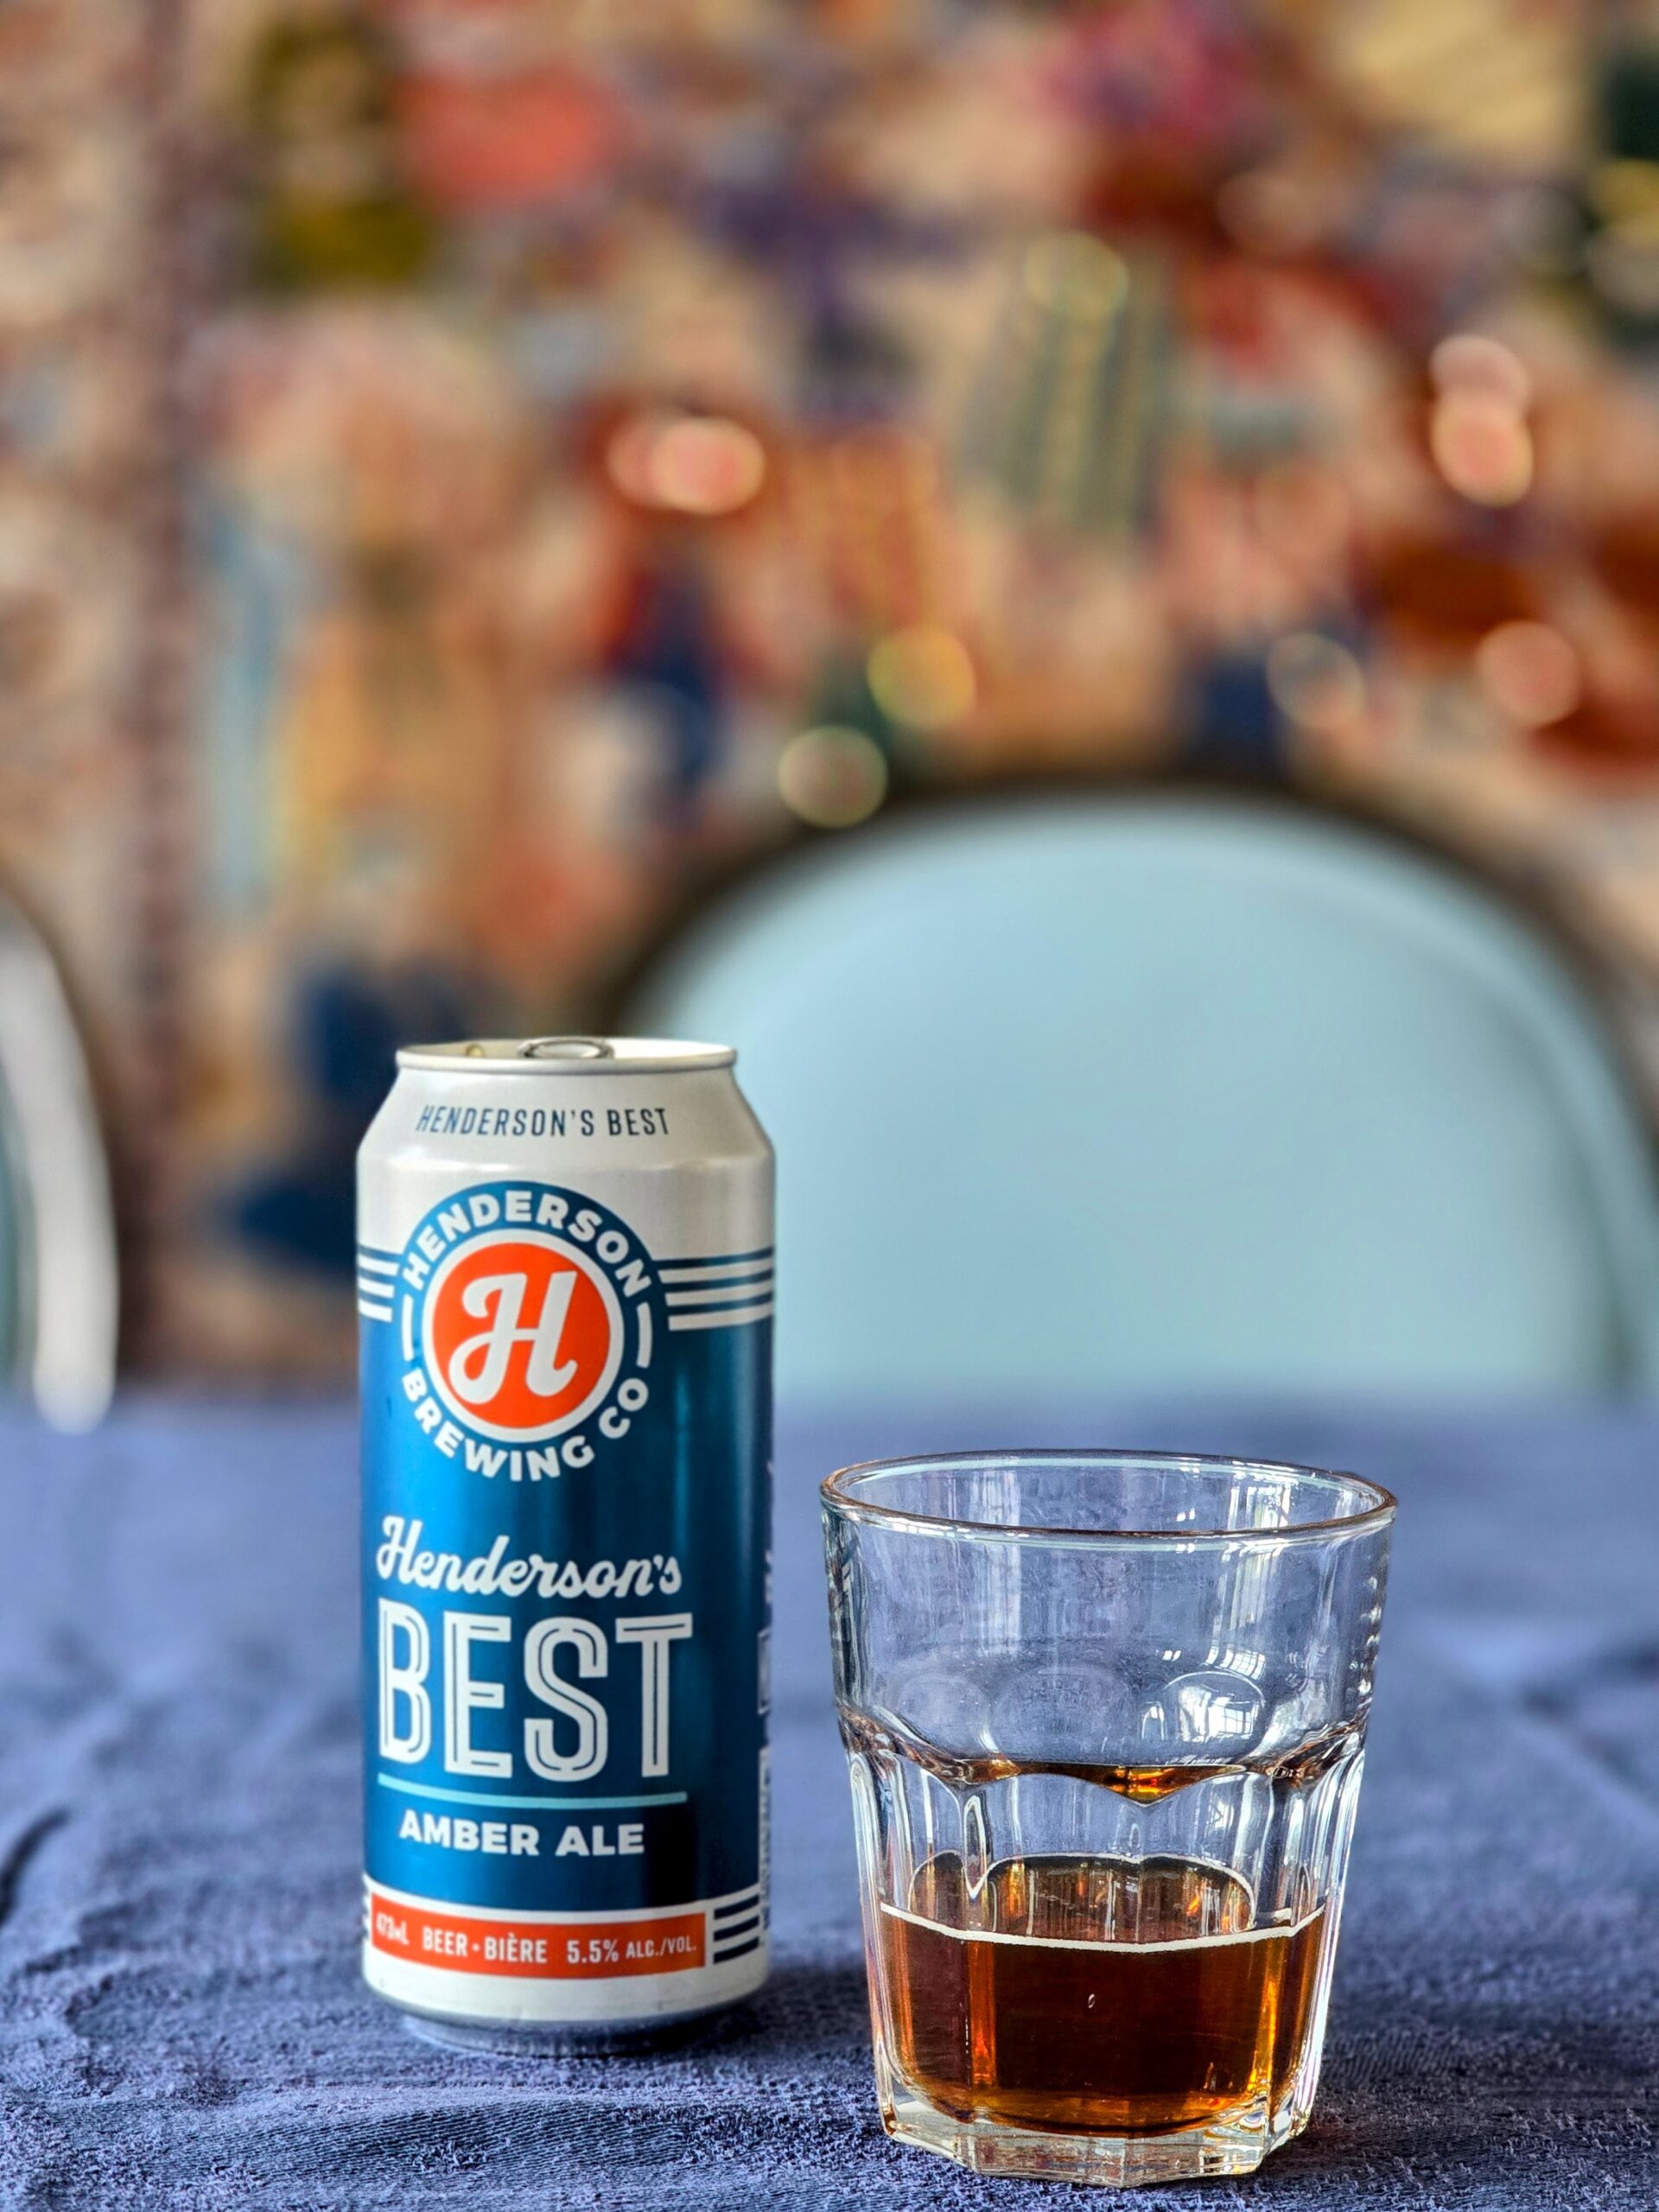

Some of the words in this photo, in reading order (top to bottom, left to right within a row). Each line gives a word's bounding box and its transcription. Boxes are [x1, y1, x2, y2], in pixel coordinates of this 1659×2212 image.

[415, 1105, 594, 1137] HENDERSON'S
[608, 1108, 669, 1136] BEST
[401, 1189, 652, 1298] HENDERSON
[447, 1269, 579, 1406] H
[401, 1368, 595, 1482] BREWING
[599, 1378, 649, 1440] CO
[376, 1515, 682, 1599] Henderson's
[378, 1596, 692, 1782] BEST
[400, 1809, 540, 1857] AMBER
[555, 1823, 645, 1856] ALE
[422, 1925, 468, 1957] BEER
[484, 1932, 548, 1964] BIÈRE
[566, 1939, 620, 1964] 5.5%
[626, 1935, 697, 1960] ALC./VOL.
